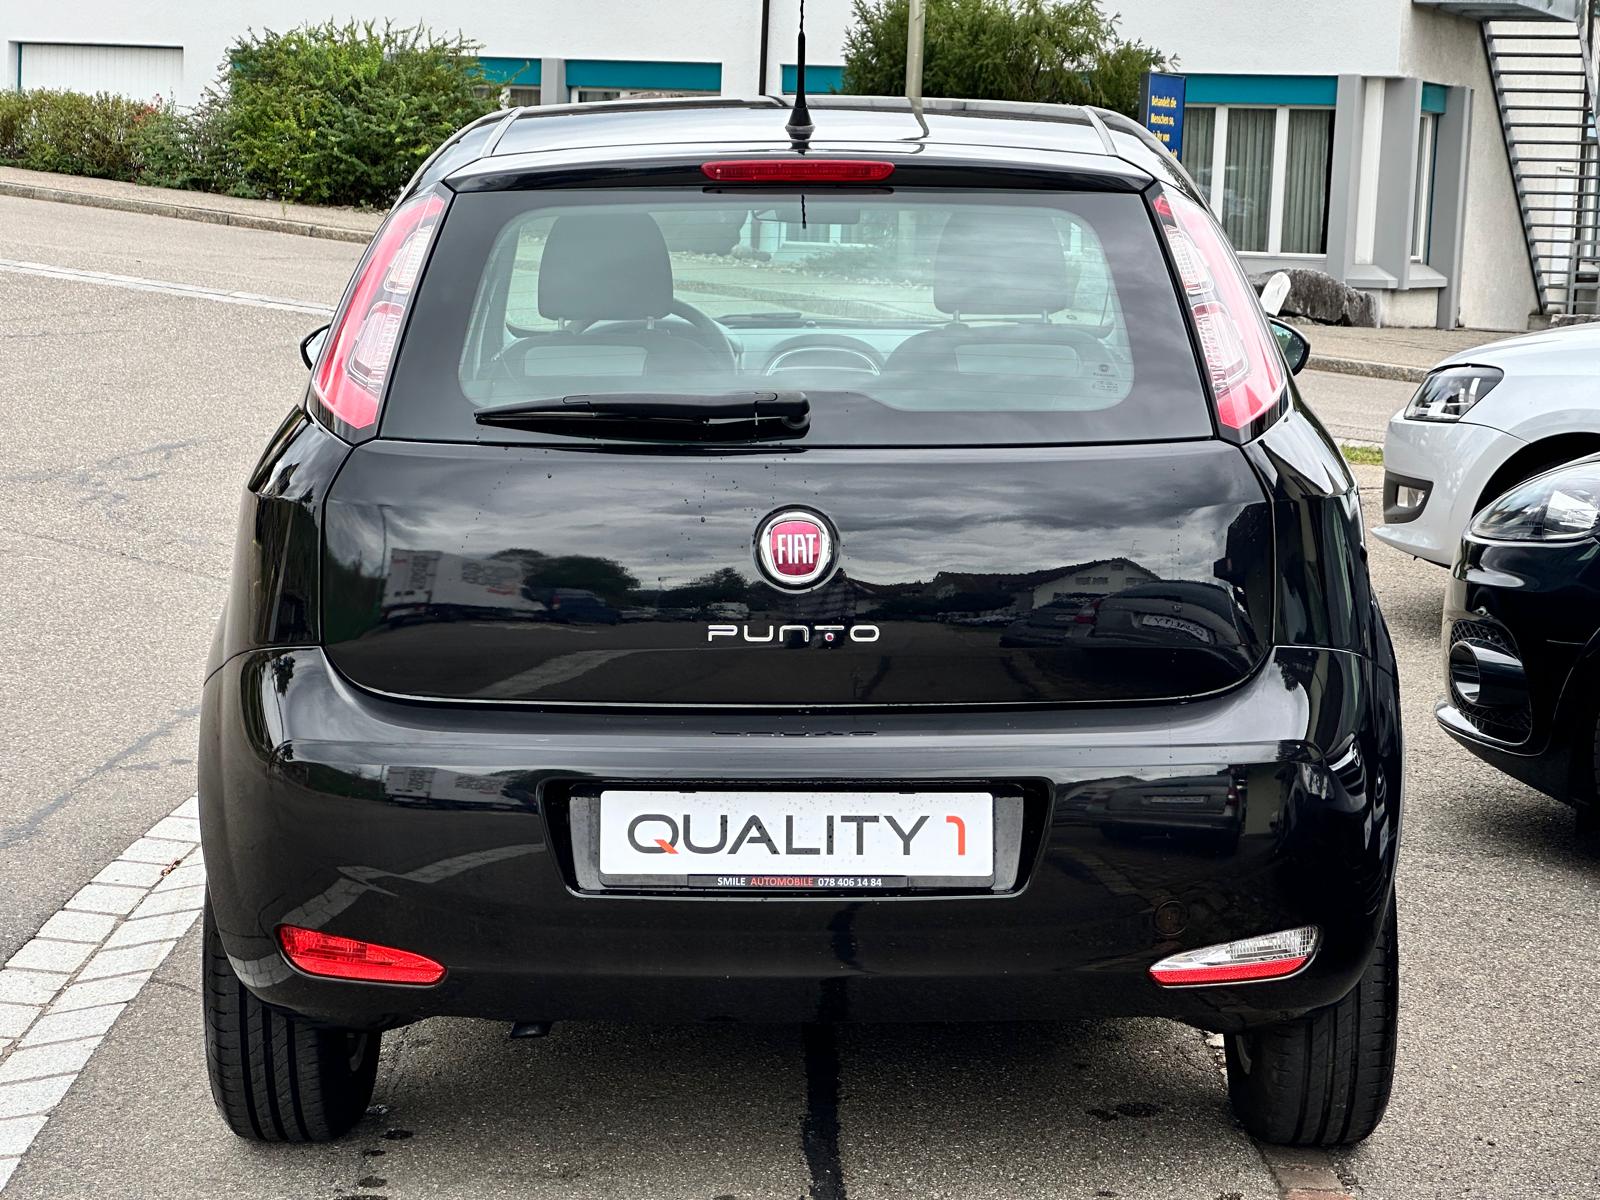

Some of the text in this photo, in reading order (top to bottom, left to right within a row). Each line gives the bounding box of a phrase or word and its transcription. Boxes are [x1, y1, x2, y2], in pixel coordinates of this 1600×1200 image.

[1150, 113, 1169, 124] Menschen
[777, 533, 816, 565] FIAT
[707, 624, 880, 643] PUNTO
[628, 814, 966, 856] QUALITY 1
[717, 876, 882, 887] SMILE AUTOMOBILE 078 406 14 84
